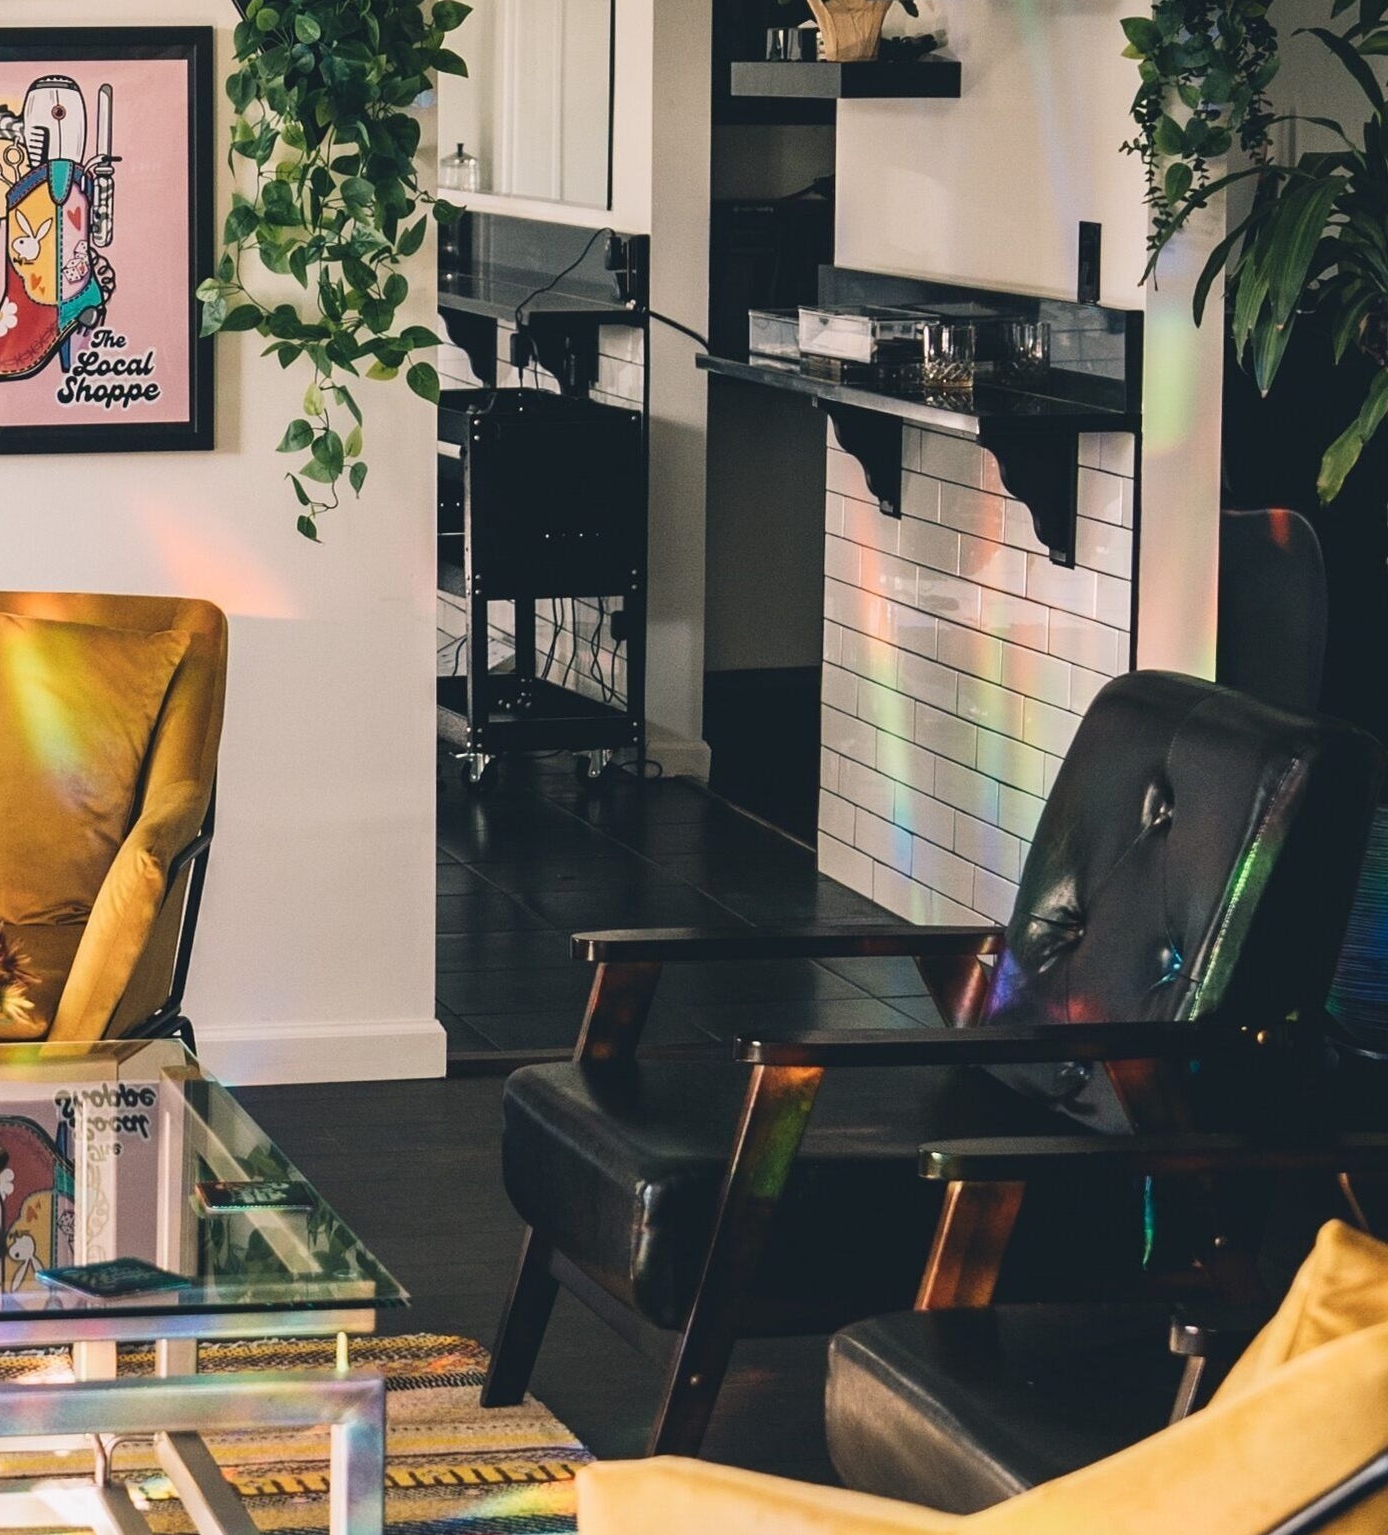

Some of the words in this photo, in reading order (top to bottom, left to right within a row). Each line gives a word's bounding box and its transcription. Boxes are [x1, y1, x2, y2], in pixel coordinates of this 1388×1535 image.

[90, 329, 127, 348] The
[72, 351, 154, 376] Local
[57, 376, 161, 408] Shoppe
